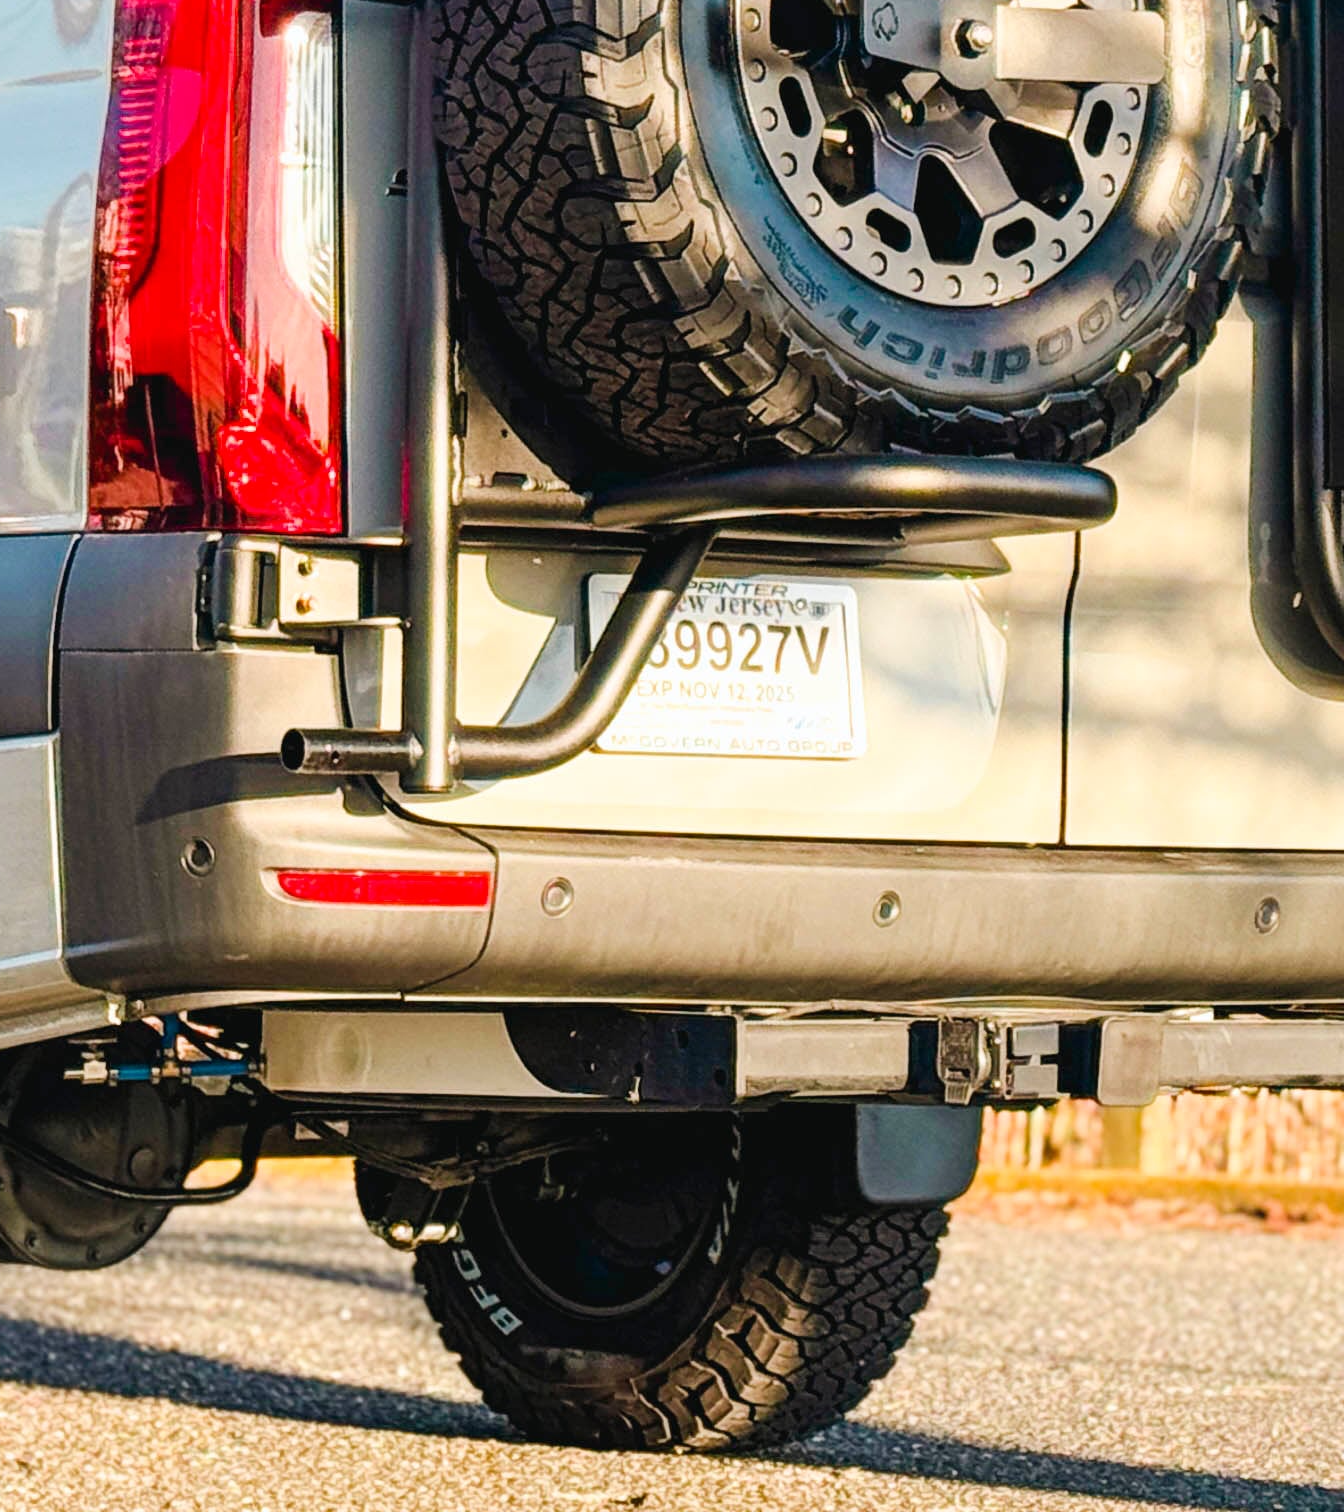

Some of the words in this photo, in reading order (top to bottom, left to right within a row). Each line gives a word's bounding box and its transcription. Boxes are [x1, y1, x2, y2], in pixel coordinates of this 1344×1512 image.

[637, 680, 673, 697] EXP
[680, 681, 719, 698] NOV
[756, 685, 795, 703] 2025
